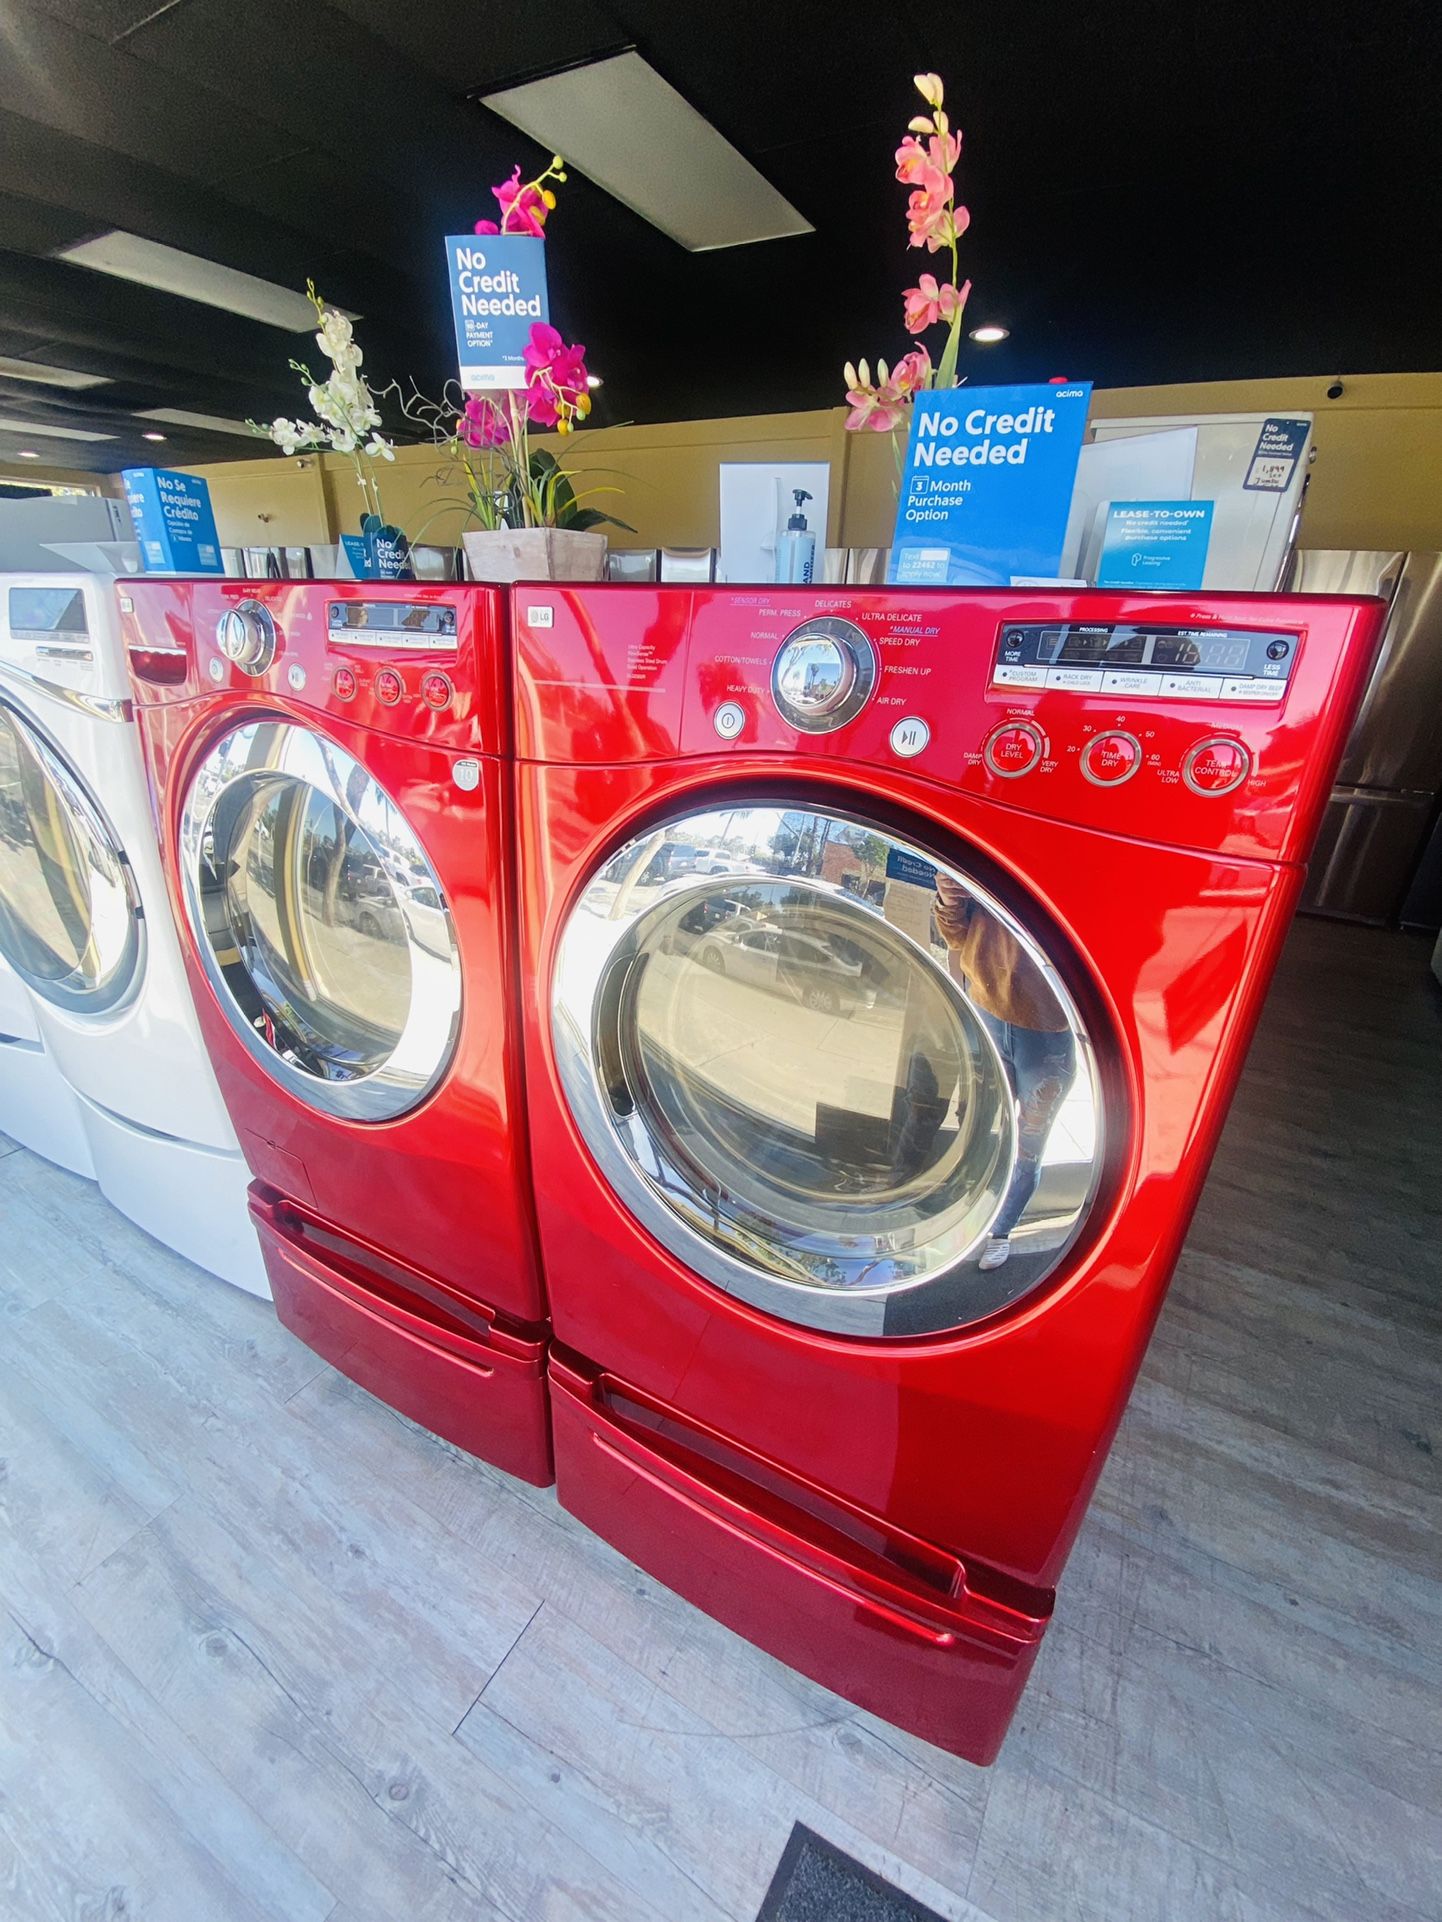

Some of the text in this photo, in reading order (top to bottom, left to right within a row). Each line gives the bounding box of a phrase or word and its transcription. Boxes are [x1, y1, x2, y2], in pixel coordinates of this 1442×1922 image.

[456, 248, 486, 270] No
[459, 270, 520, 293] Credit
[461, 294, 541, 316] Needed
[1056, 389, 1084, 398] acima
[918, 406, 1055, 437] No Credit
[1265, 424, 1279, 432] No
[1262, 433, 1289, 442] Credit
[1259, 442, 1294, 451] Needed
[913, 438, 1030, 467] Needed
[156, 476, 173, 489] No
[174, 479, 186, 492] Se
[916, 479, 971, 493] 3 Month
[160, 491, 201, 508] Requiere
[907, 495, 963, 507] Purchase
[905, 509, 949, 523] Option
[1113, 510, 1205, 518] LEASE-TO-OWN
[376, 539, 392, 549] No
[815, 600, 852, 608] DELICATES
[540, 612, 549, 621] LG
[780, 609, 801, 617] PRESS
[862, 613, 923, 622] ULTRA DELICATE
[925, 627, 941, 635] DRY
[904, 638, 921, 646] DRY
[714, 655, 768, 665] COTTON/TOWELS
[884, 666, 932, 675] FRESHEN UP
[747, 686, 766, 694] DUTY
[876, 697, 906, 706] AIR DRY
[1006, 708, 1035, 716] NORMAL
[1006, 743, 1022, 751] DRY
[1000, 751, 1024, 759] LEVEL
[1101, 751, 1121, 760] TIME
[1101, 759, 1118, 767] DRY
[460, 768, 473, 781] 10
[1194, 767, 1238, 777] CONTROL
